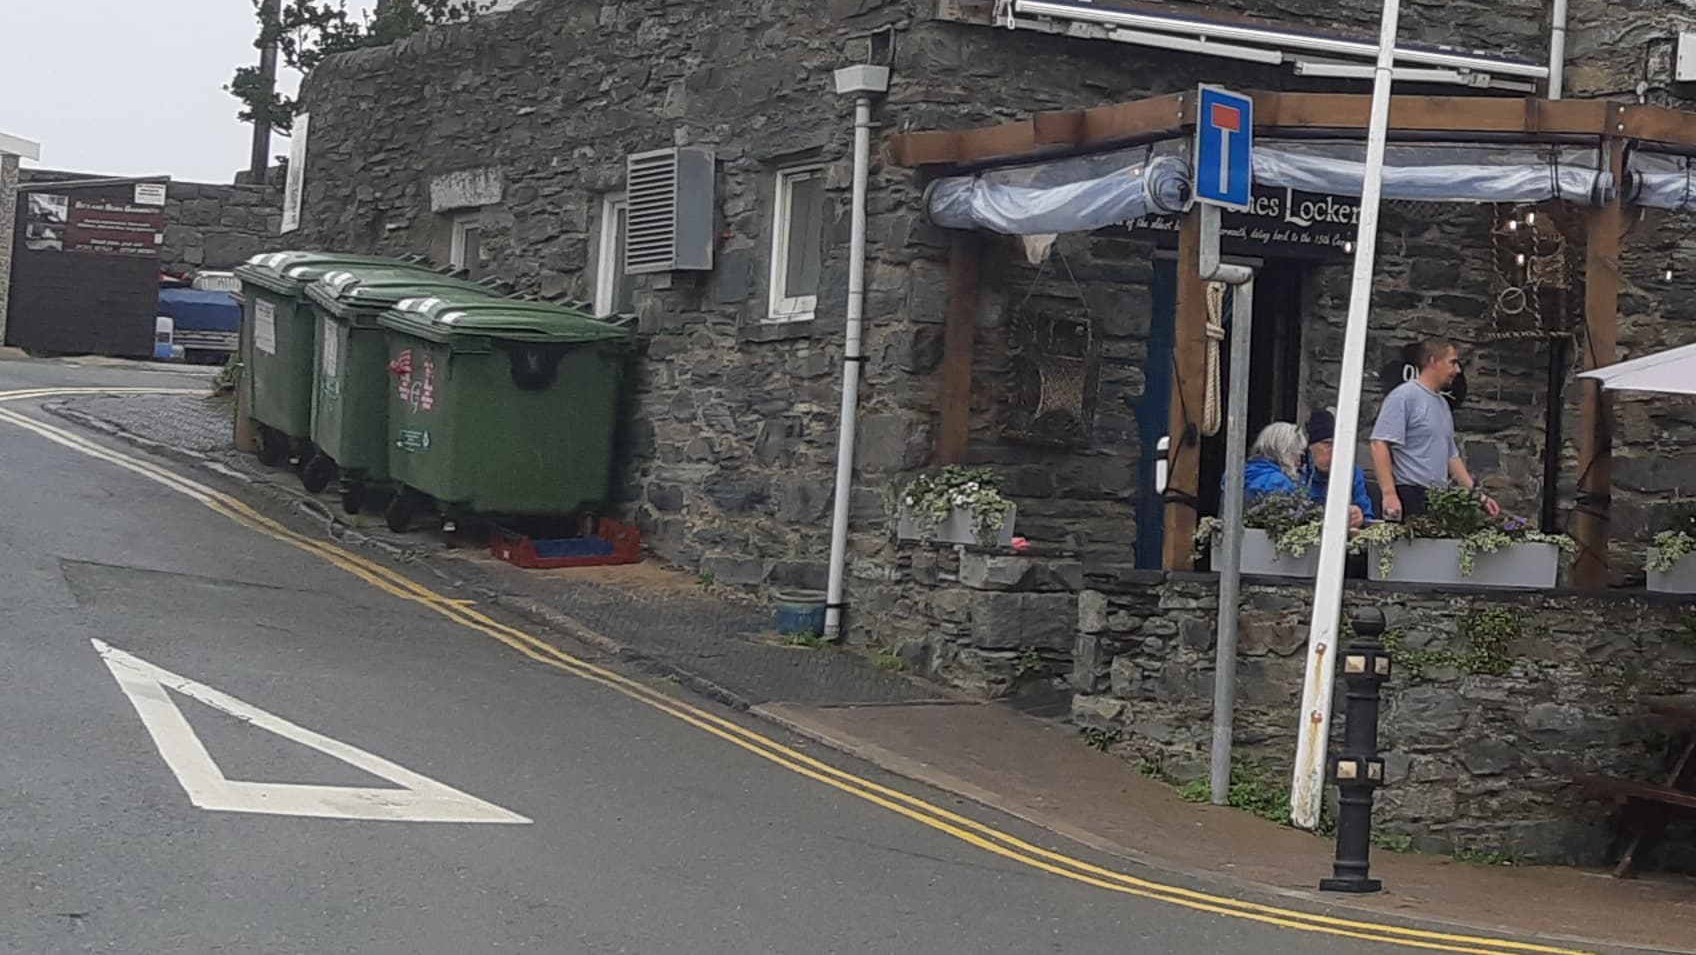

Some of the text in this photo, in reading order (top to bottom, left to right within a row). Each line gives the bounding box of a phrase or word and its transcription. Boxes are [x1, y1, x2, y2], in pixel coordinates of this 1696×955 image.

[1284, 187, 1361, 227] Locker
[1250, 227, 1271, 244] dating
[1291, 232, 1299, 242] to
[1300, 231, 1312, 244] the
[1314, 233, 1331, 245] 15th
